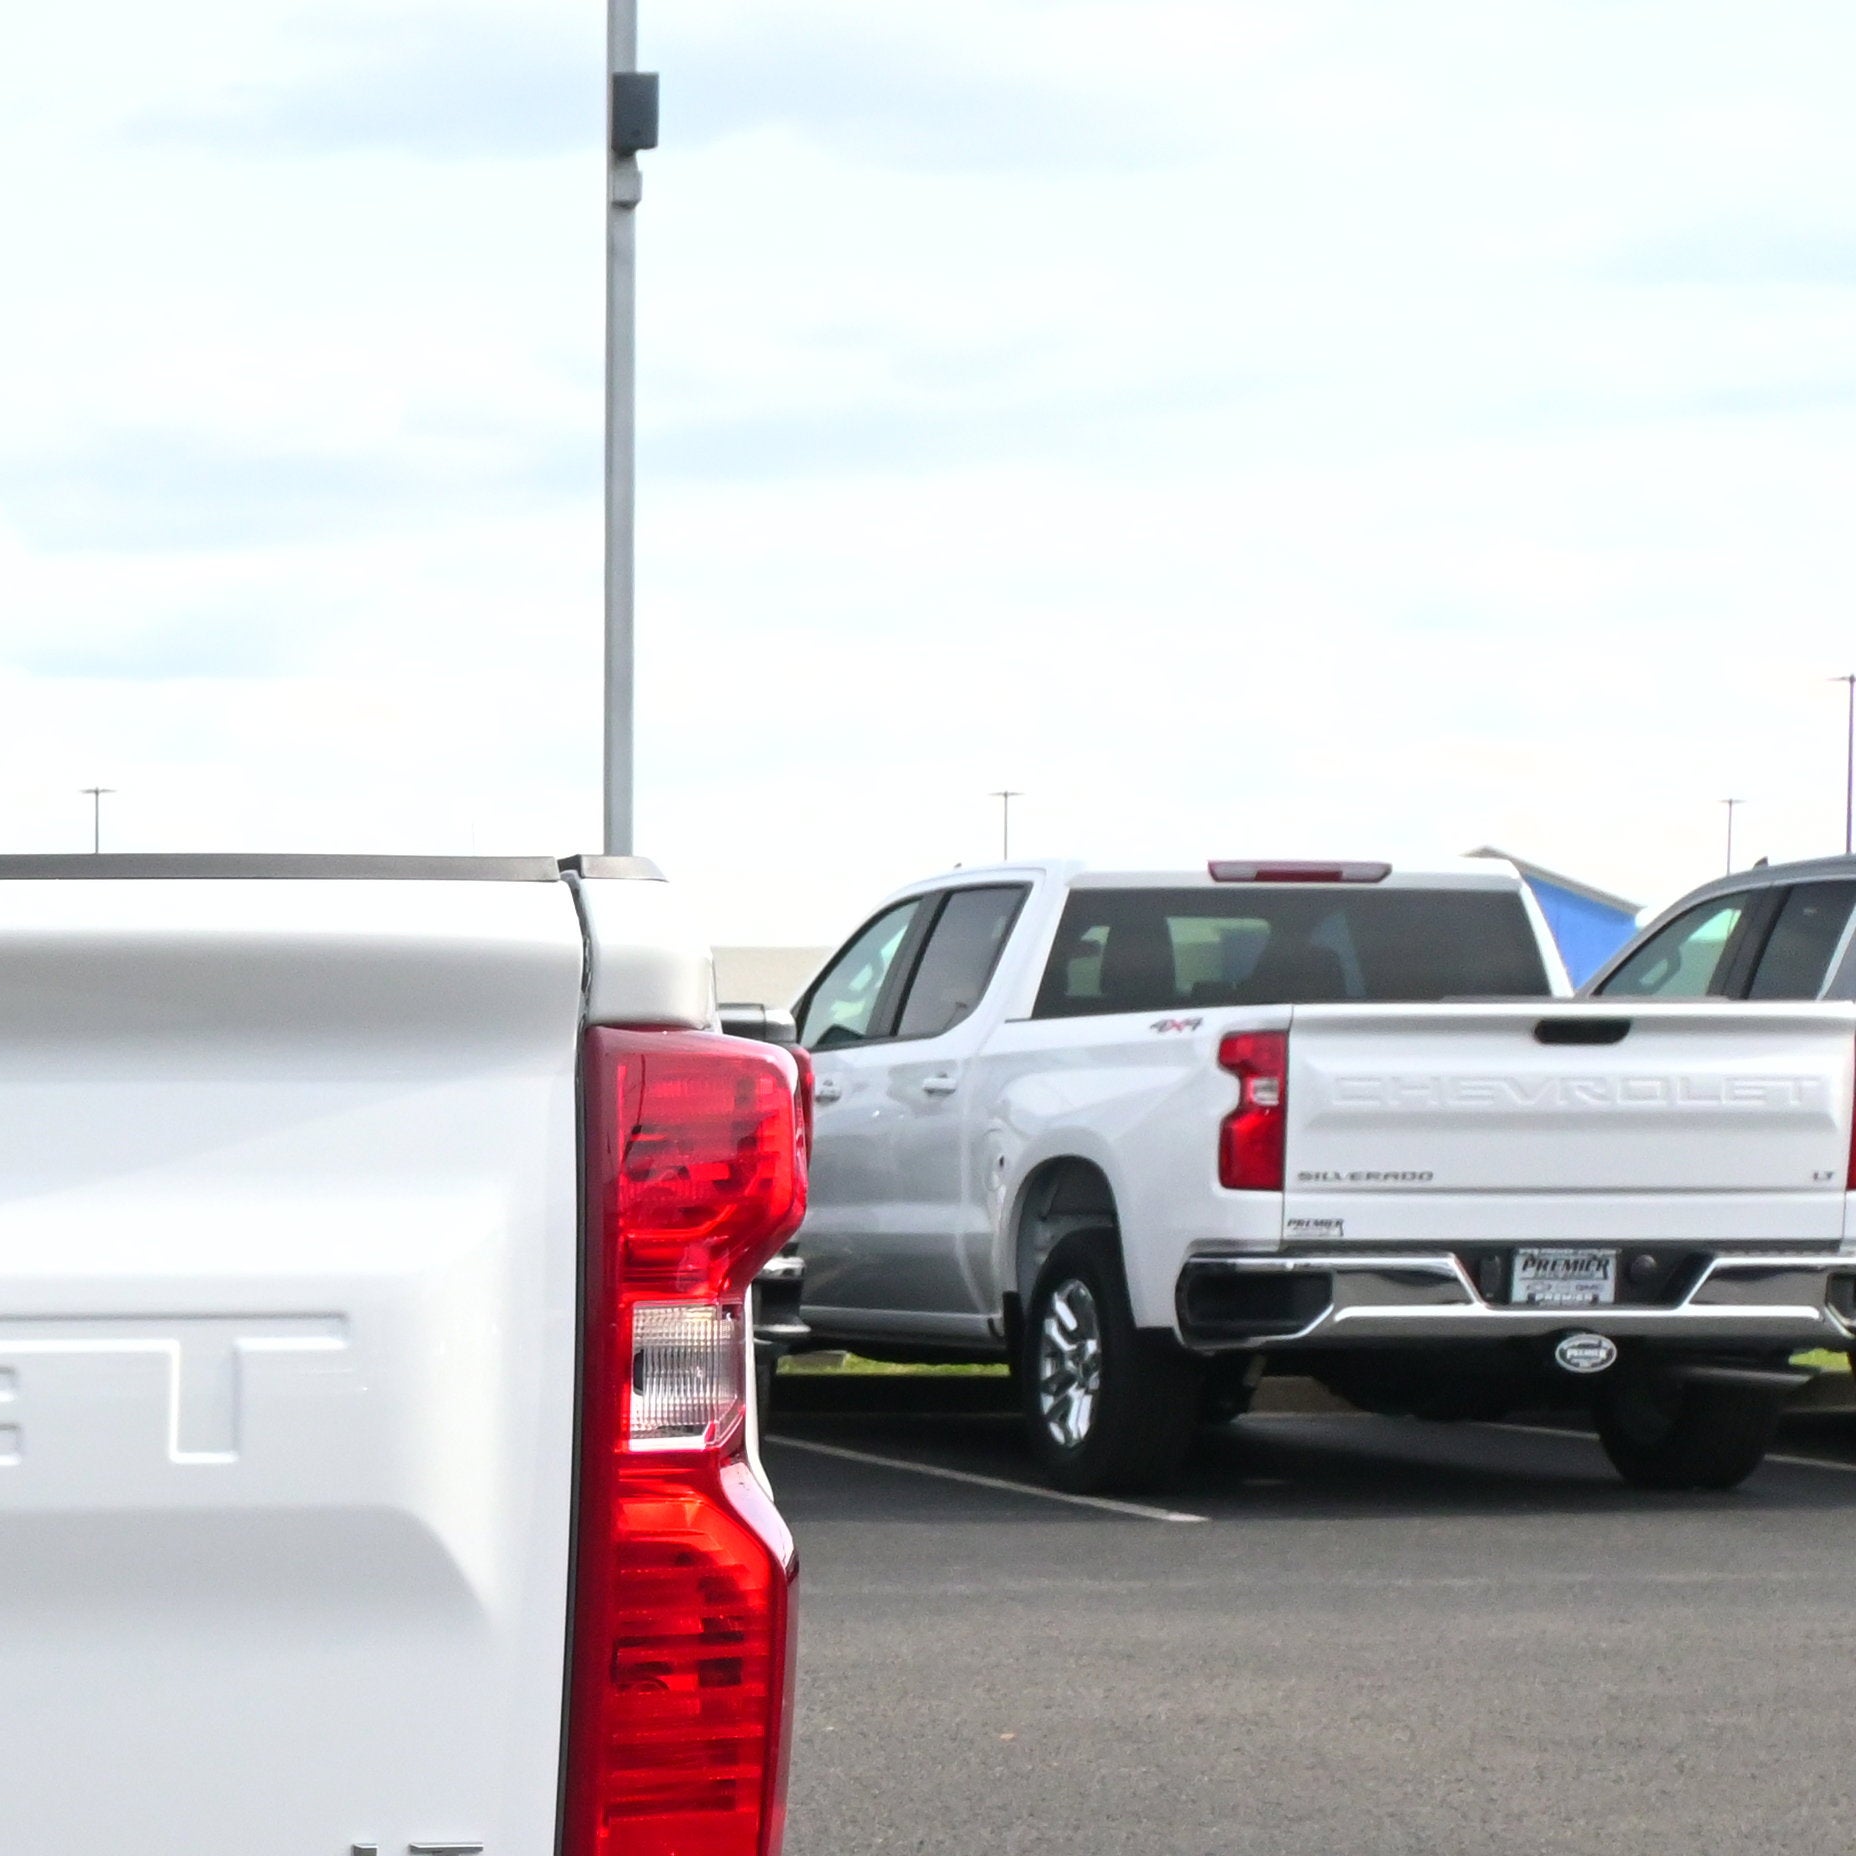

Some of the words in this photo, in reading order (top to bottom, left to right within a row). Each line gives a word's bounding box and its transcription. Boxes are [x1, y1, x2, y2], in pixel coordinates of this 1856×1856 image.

[1330, 1076, 1823, 1107] CHEVROLET
[1297, 1171, 1434, 1183] SILVERADO
[1522, 1257, 1610, 1273] PREMIER
